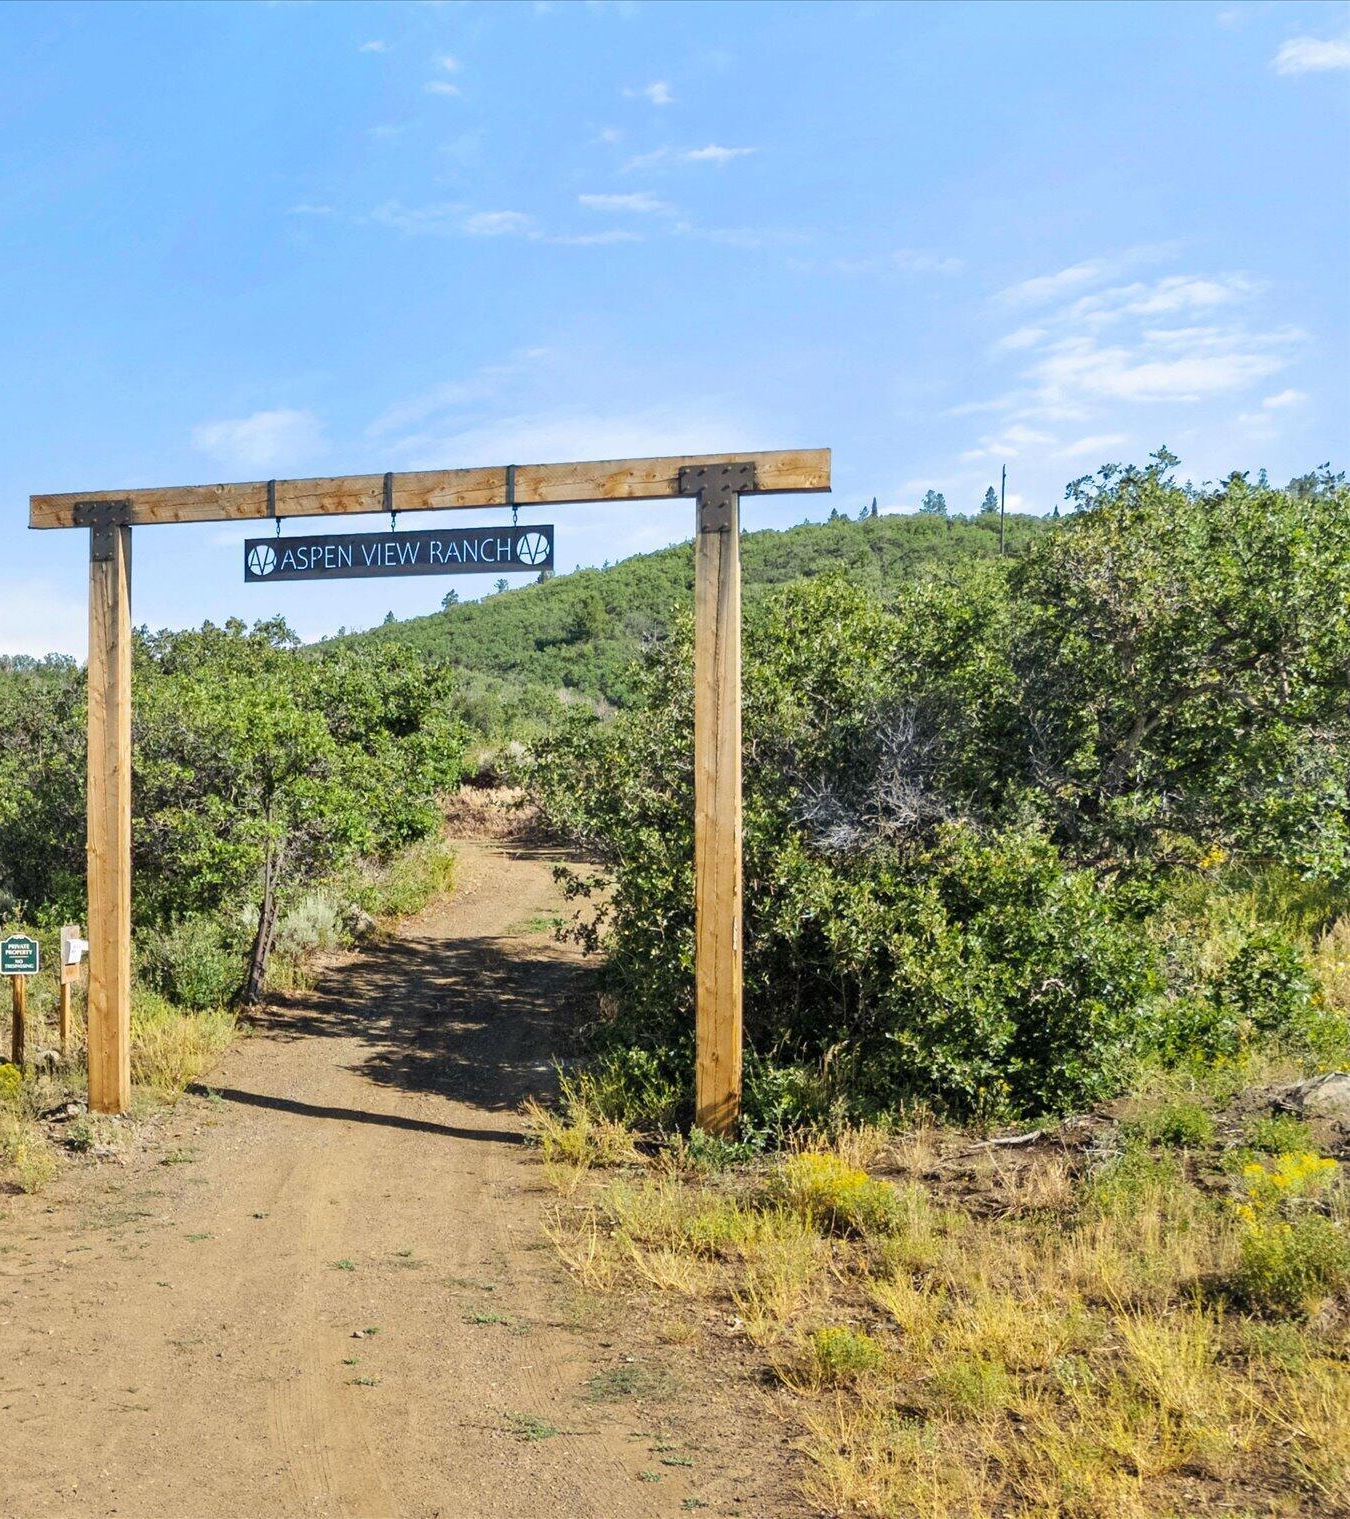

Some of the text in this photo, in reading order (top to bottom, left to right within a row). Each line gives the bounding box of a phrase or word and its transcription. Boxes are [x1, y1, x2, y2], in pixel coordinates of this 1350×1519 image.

[280, 544, 352, 570] ASPEN
[361, 541, 421, 566] VIEW
[430, 538, 511, 564] RANCH
